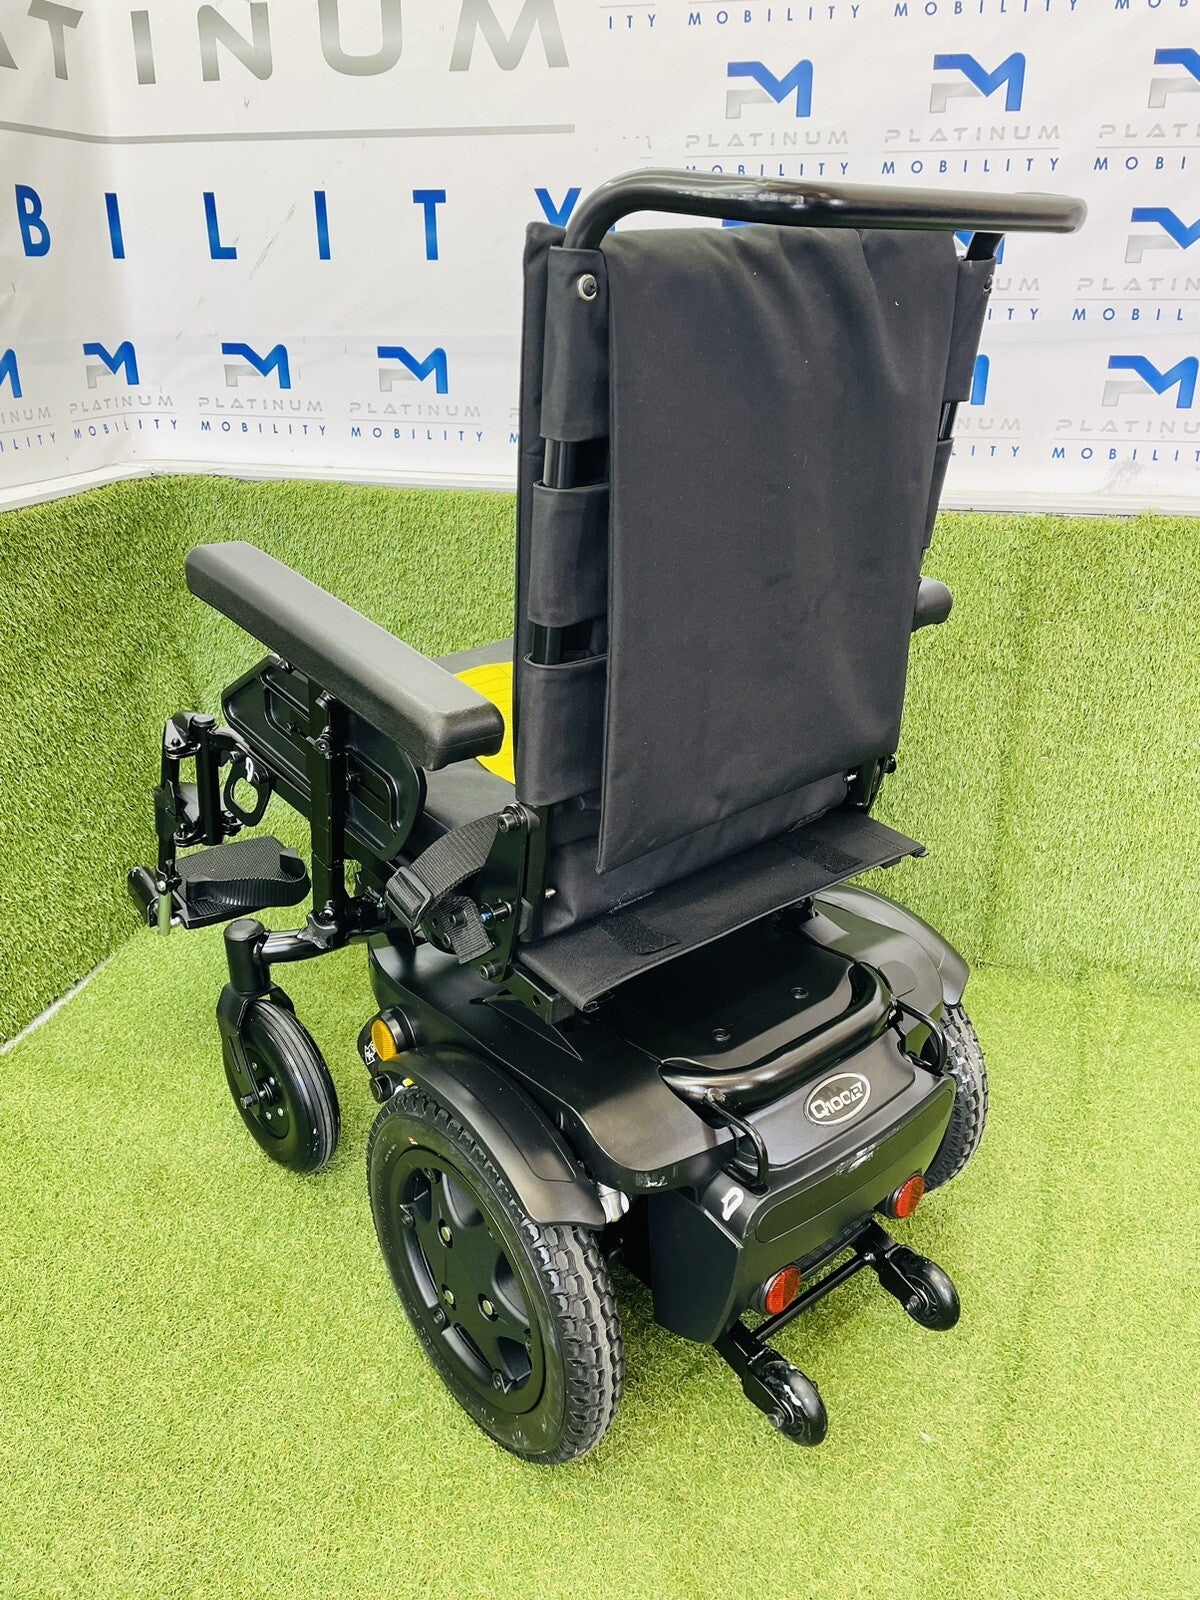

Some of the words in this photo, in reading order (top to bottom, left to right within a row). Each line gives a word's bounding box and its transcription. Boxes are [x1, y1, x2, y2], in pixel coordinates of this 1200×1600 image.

[688, 5, 859, 26] MOBILITY
[686, 131, 848, 148] PLATINUM
[885, 125, 1060, 143] PLATINUM
[882, 158, 1059, 174] MOBILITY
[1094, 156, 1186, 170] MOBI
[1072, 308, 1183, 321] MOBIL
[70, 395, 173, 414] PLATINUM
[199, 397, 323, 412] PLATINUM
[350, 402, 481, 417] PLATINUM
[74, 419, 177, 439] MOBILITY
[201, 421, 325, 435] MOBILITY
[351, 427, 483, 442] MOBILITY
